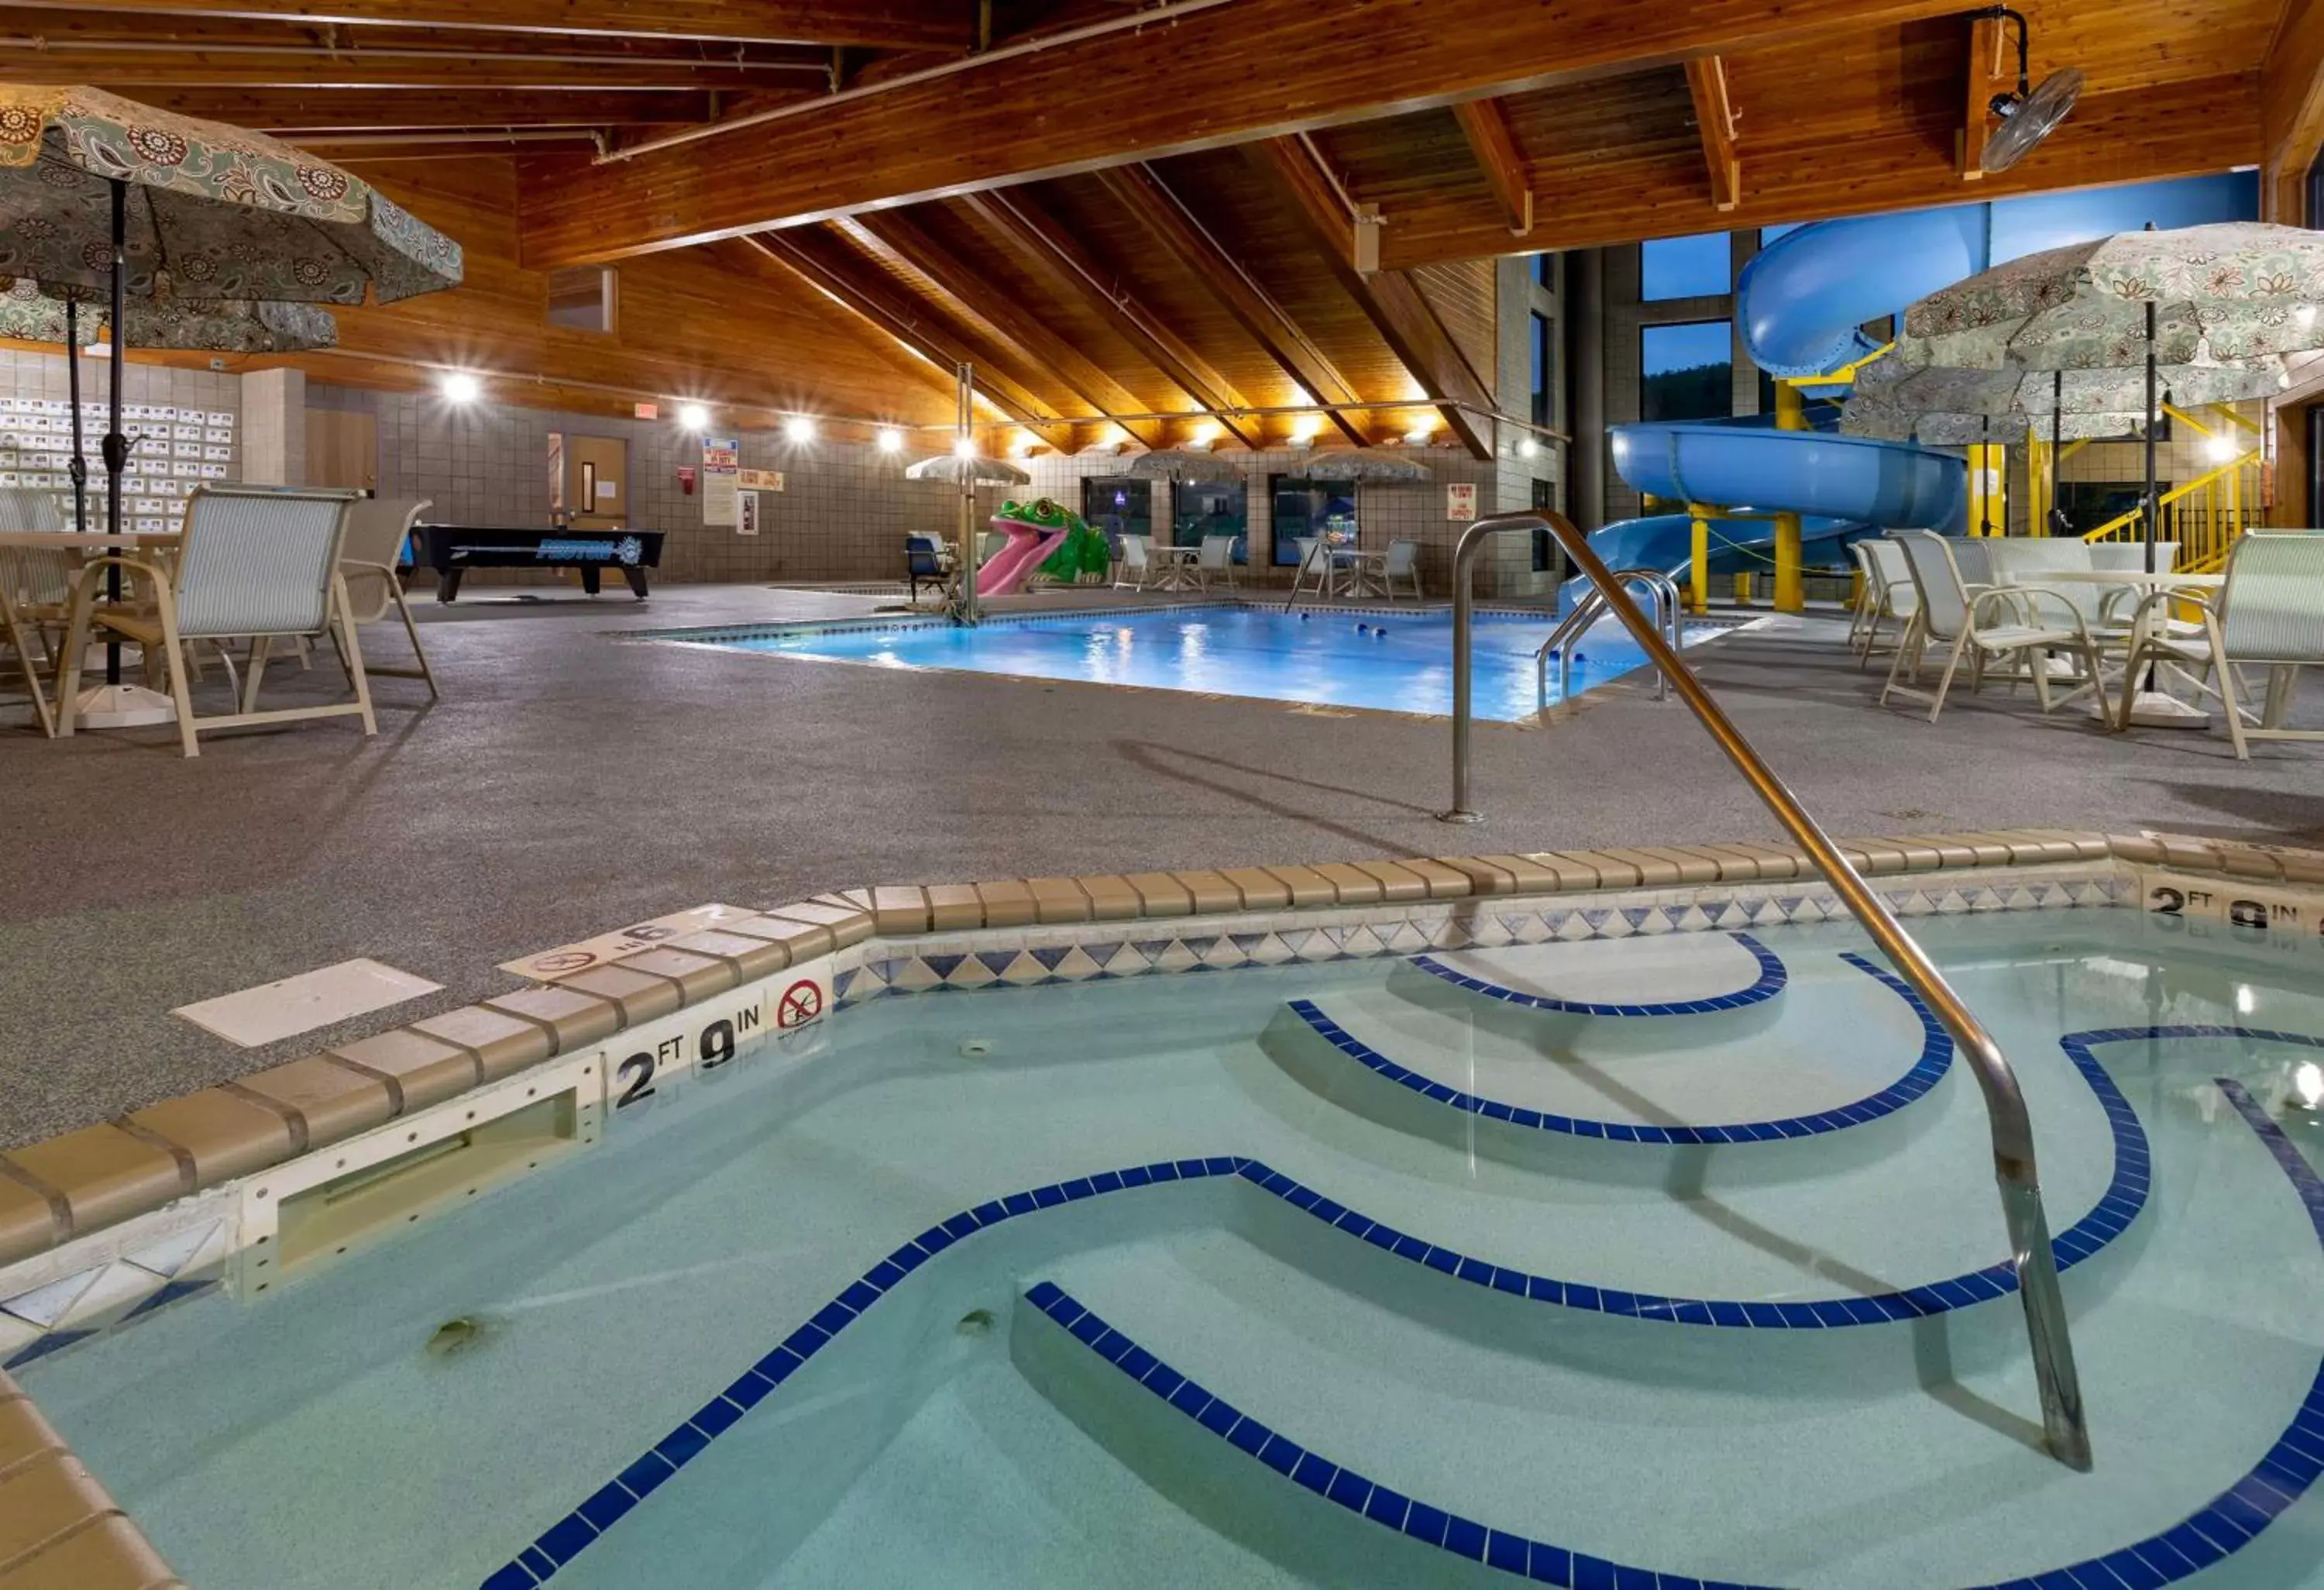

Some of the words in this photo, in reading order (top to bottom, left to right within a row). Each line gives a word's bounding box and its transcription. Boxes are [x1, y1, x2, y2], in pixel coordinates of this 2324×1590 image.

[2150, 887, 2185, 917] 2
[2188, 891, 2212, 907] FT
[2271, 904, 2297, 921] IN
[617, 1051, 655, 1109] 2
[658, 1035, 683, 1065] FT
[700, 1019, 735, 1069] 9
[737, 1004, 759, 1033] IN
